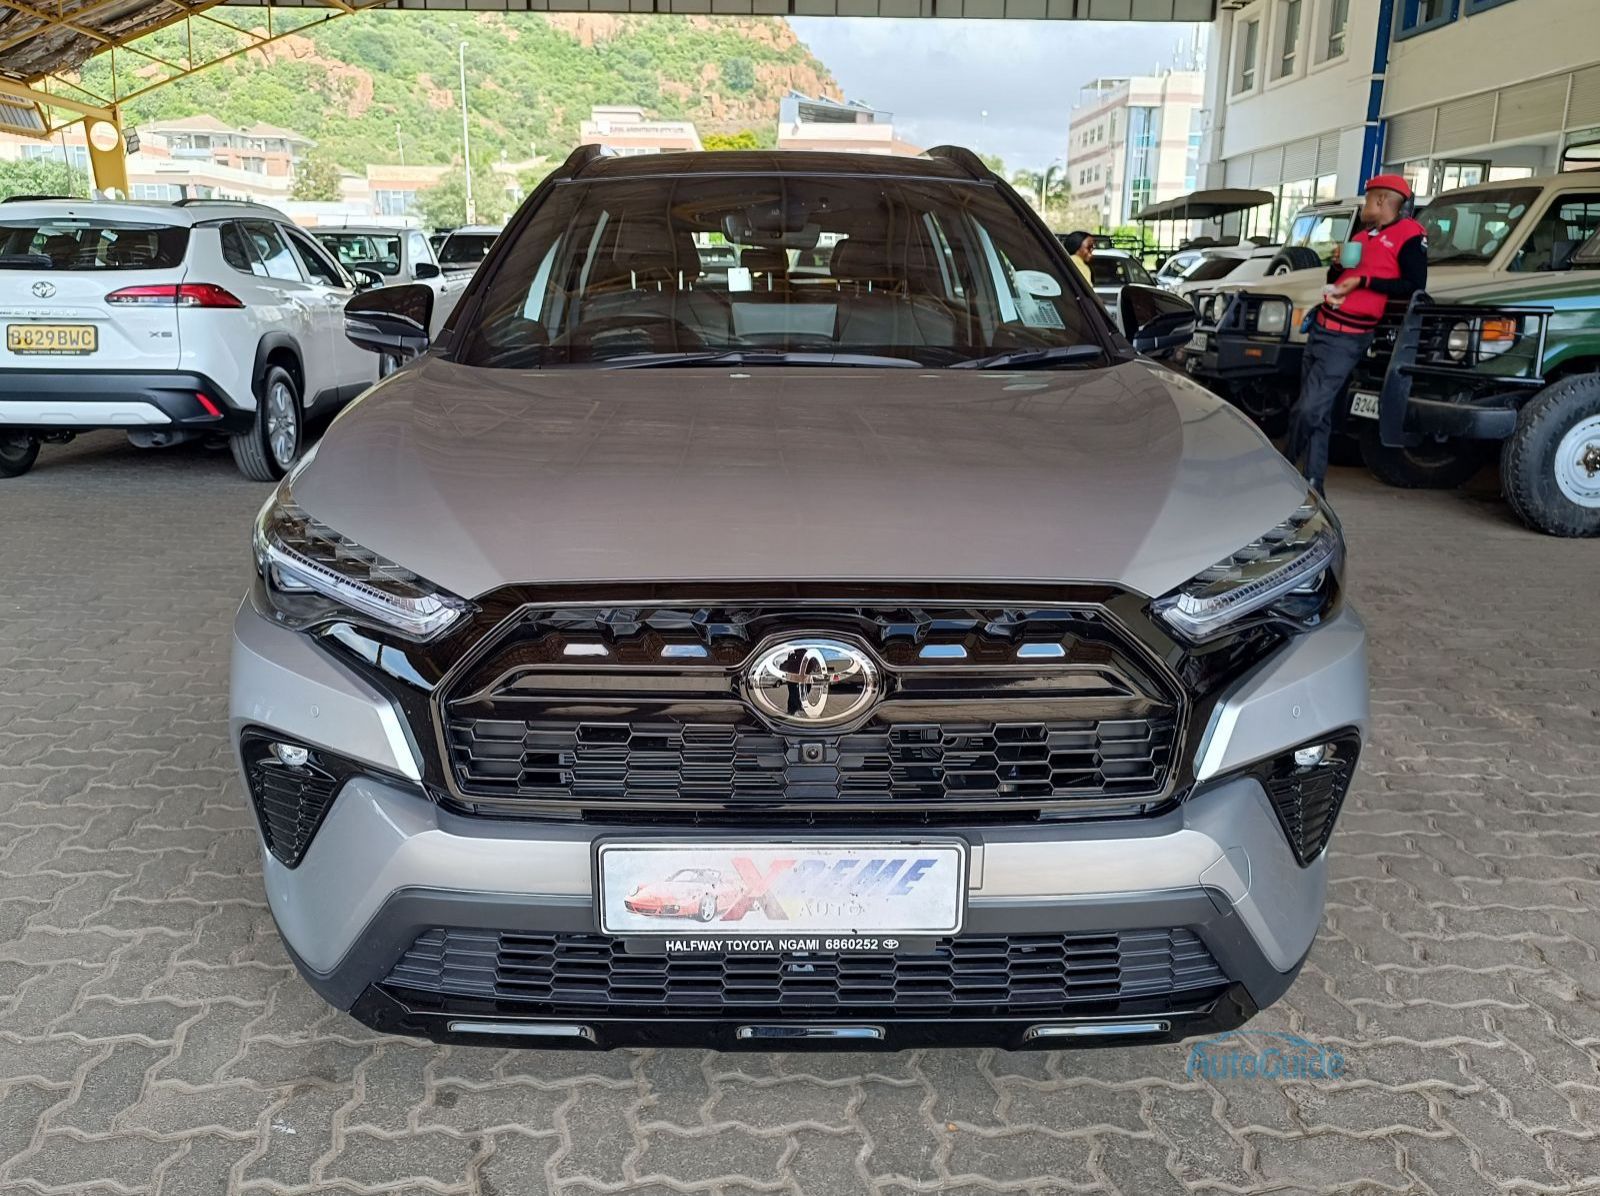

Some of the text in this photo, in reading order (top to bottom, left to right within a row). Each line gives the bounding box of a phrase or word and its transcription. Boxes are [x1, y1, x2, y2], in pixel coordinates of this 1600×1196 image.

[664, 938, 879, 952] HALFWAY TOYOTA NGAMI 6860252
